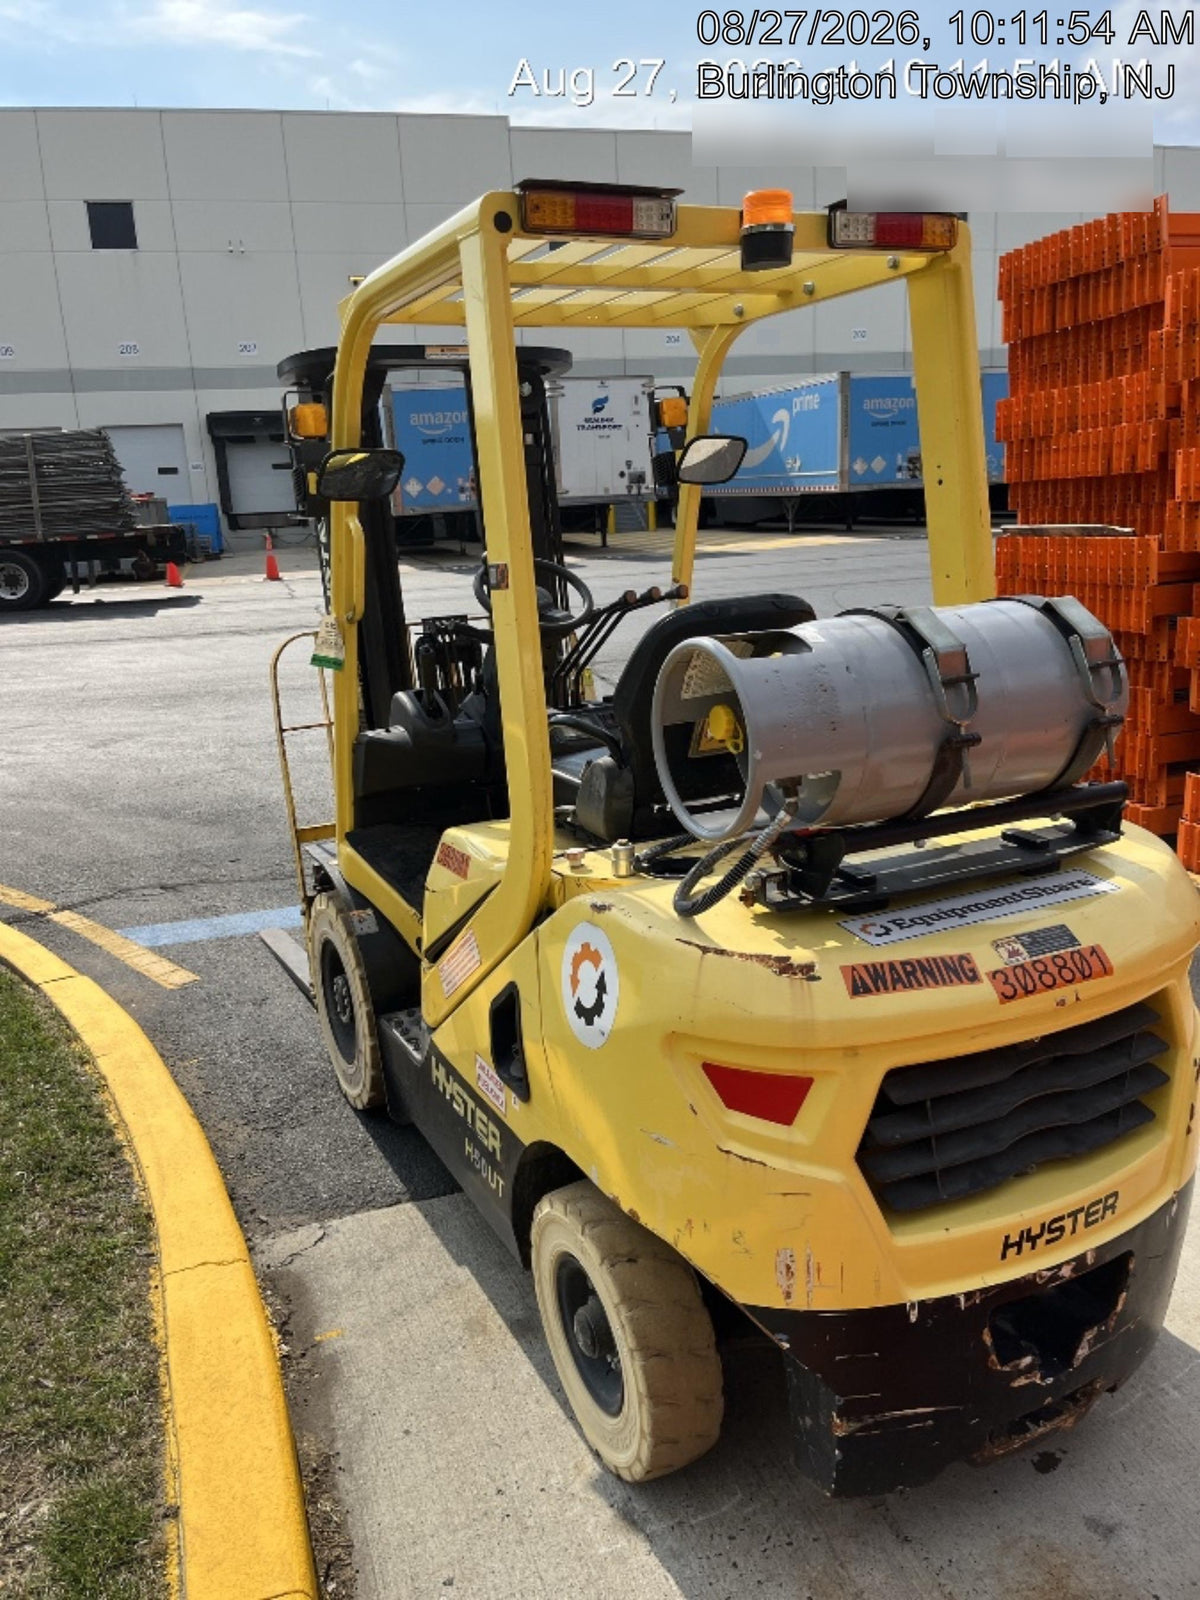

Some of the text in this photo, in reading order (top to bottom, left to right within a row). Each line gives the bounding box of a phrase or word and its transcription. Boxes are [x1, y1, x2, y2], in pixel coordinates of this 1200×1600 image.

[792, 389, 820, 417] prime
[863, 397, 914, 411] amazon
[888, 875, 1095, 932] EquipmentShare
[863, 953, 979, 994] WARNING
[992, 945, 1108, 1001] 308801
[431, 1055, 502, 1162] HYSTER
[1000, 1190, 1120, 1261] HYSTER
